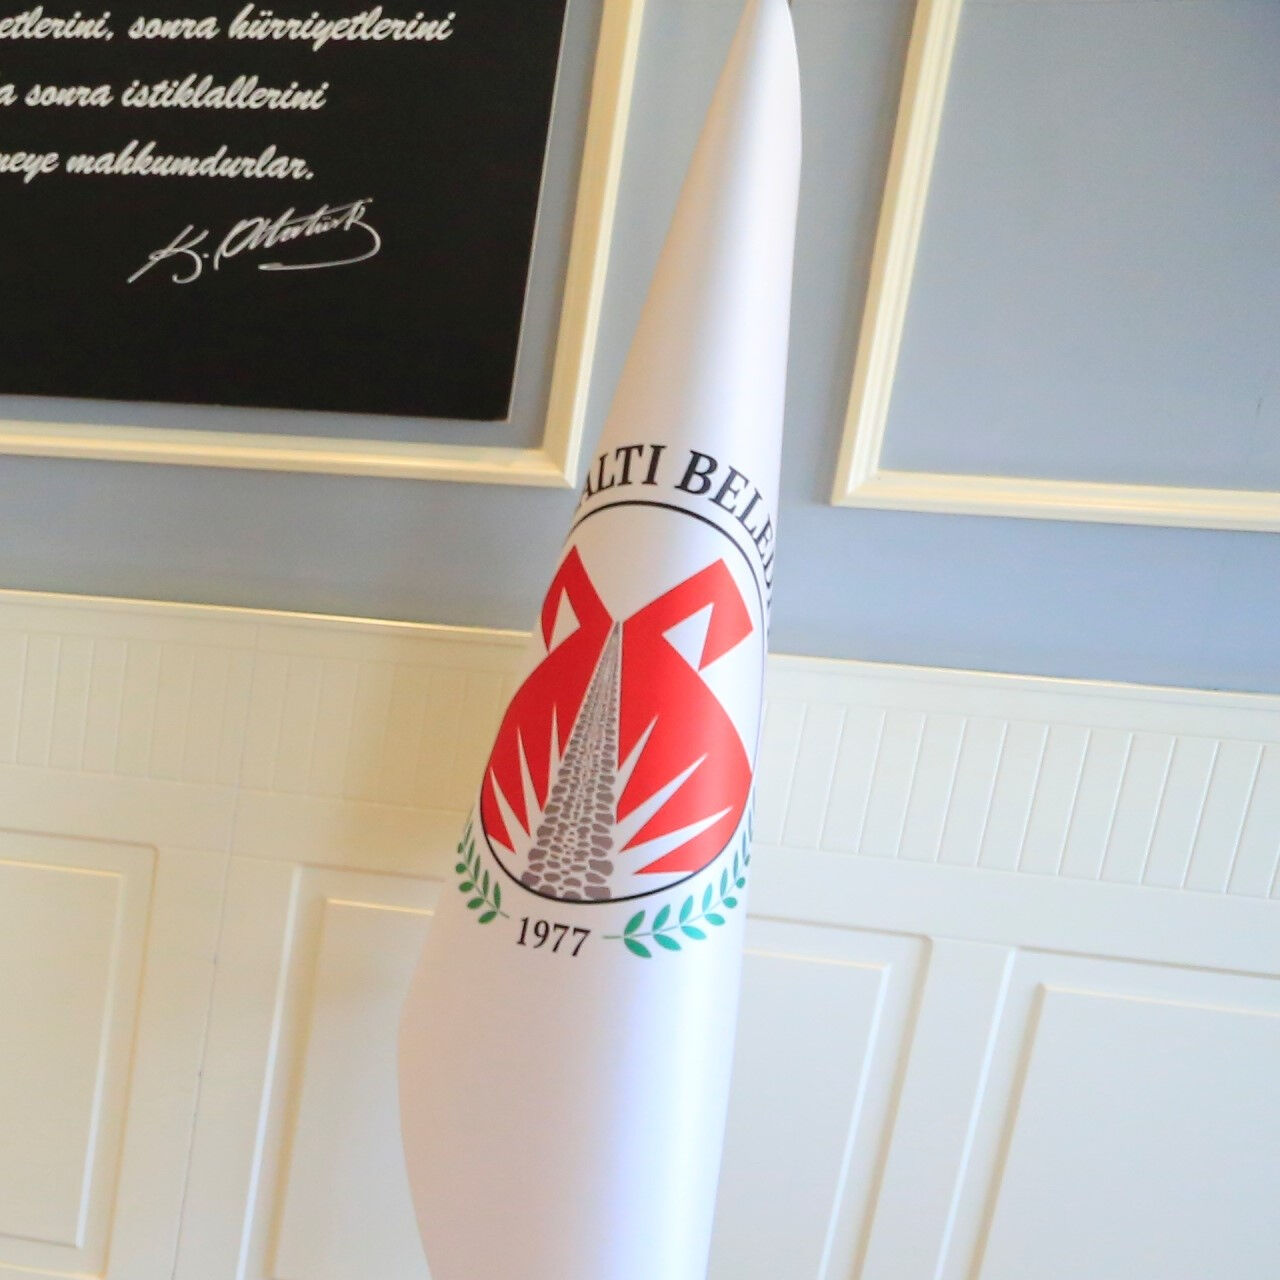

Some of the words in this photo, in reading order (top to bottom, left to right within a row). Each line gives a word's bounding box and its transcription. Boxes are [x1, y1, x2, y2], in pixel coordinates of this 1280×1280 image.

[128, 17, 220, 39] sonra
[228, 3, 456, 51] hürriyetlerini
[25, 84, 114, 107] sonra
[121, 73, 329, 110] istiklallerini
[66, 140, 314, 179] mahkumdurlar.
[516, 916, 591, 956] 1977
